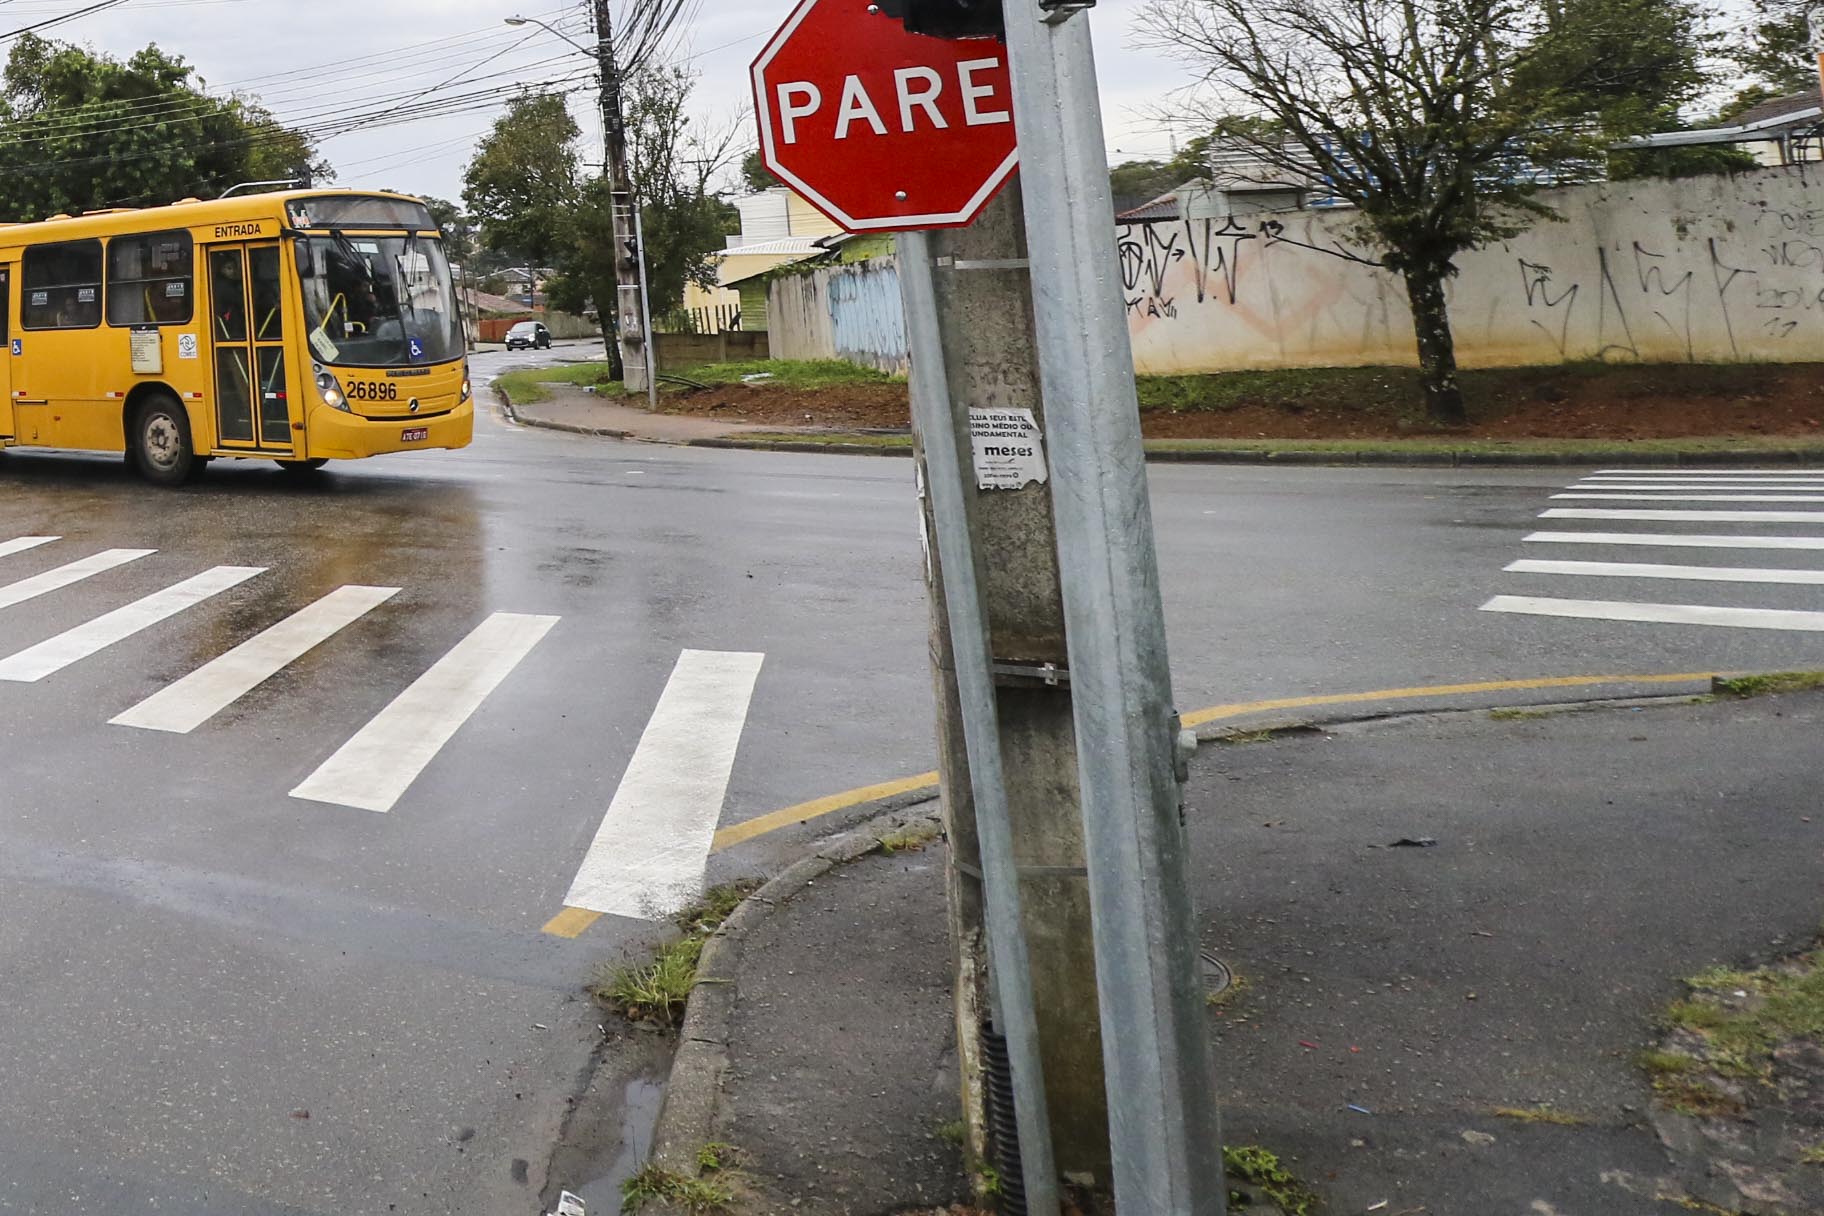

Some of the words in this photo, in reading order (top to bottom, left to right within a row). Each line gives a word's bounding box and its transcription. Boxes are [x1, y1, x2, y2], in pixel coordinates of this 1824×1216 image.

[776, 56, 1010, 145] PARE
[215, 224, 262, 238] ENTRADA
[346, 381, 397, 400] 26896
[984, 446, 1033, 457] meses
